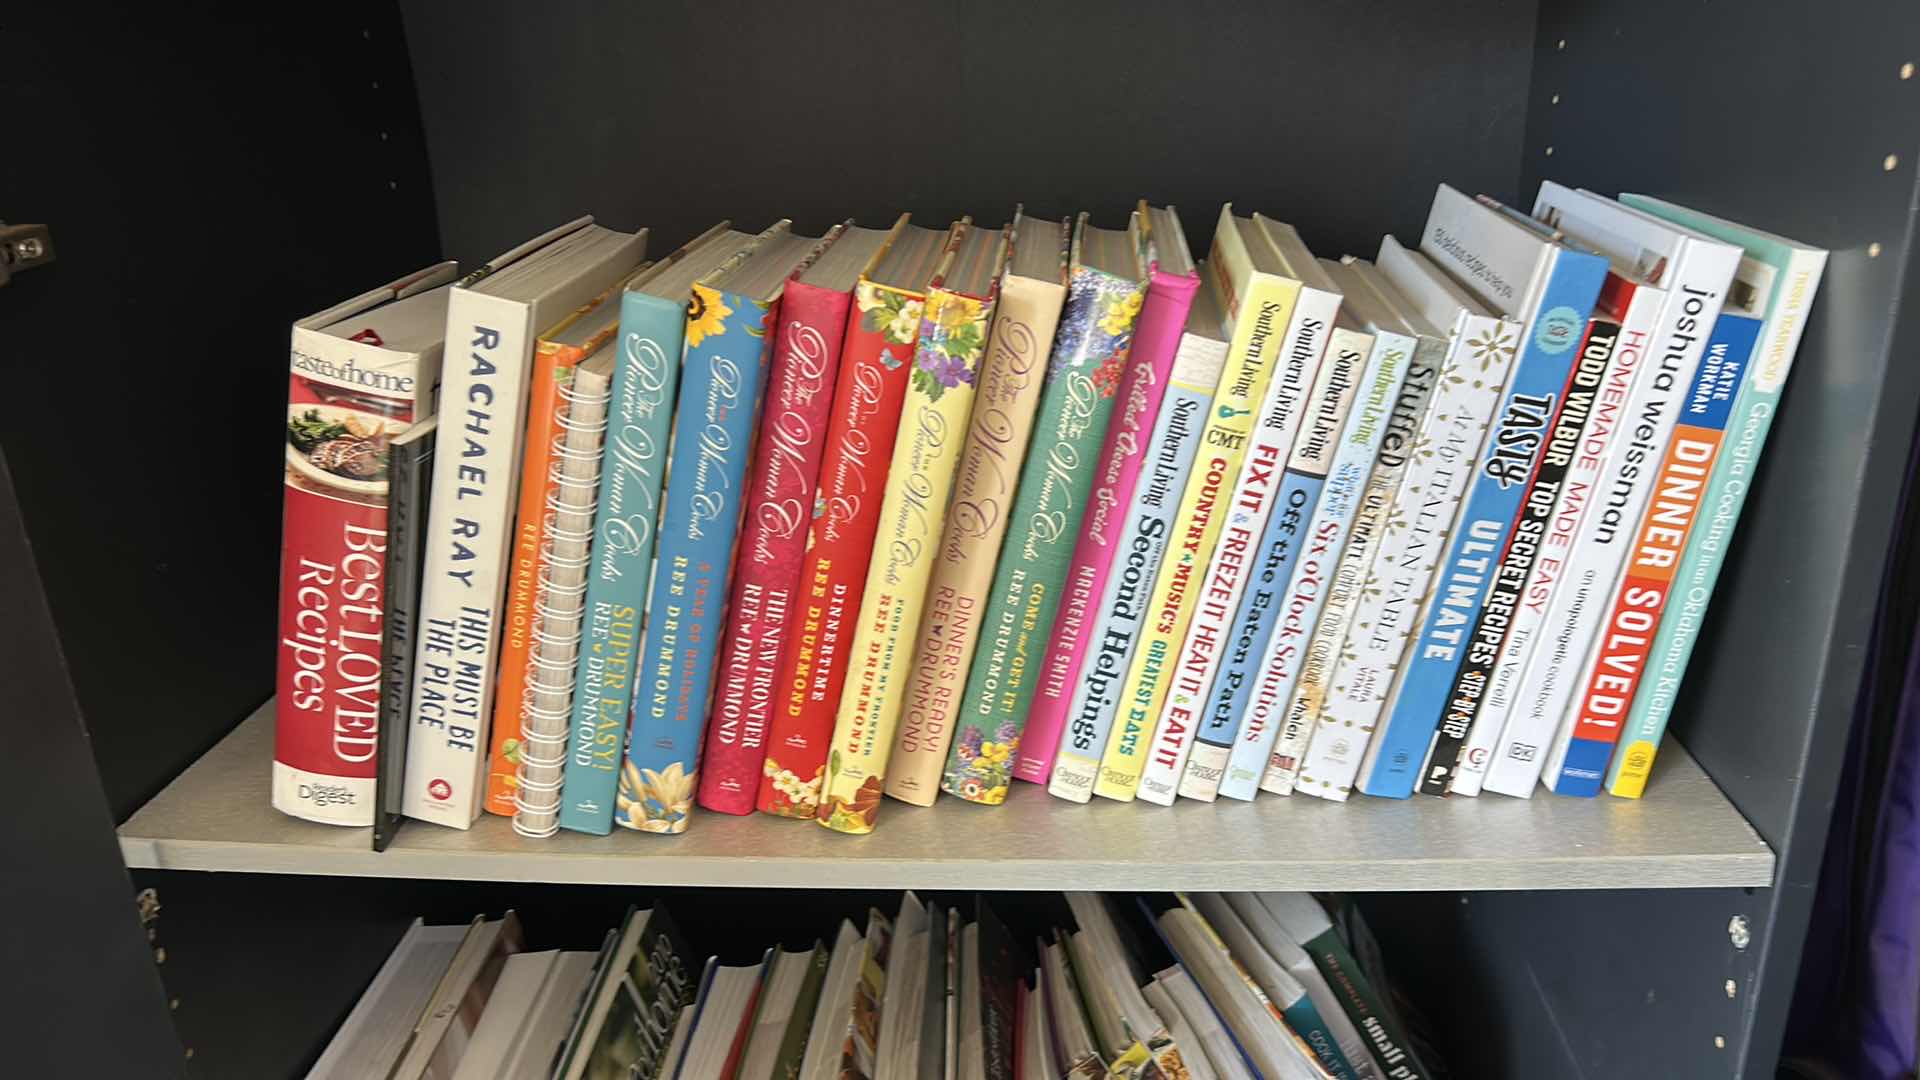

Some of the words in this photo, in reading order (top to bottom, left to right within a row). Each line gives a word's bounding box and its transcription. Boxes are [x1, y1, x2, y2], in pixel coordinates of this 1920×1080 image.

[780, 321, 828, 410] Pioneer
[1574, 328, 1618, 393] TODD
[1653, 285, 1715, 392] joshua
[621, 333, 668, 423] Pioneer
[1124, 362, 1156, 431] Grilled
[1578, 331, 1646, 473] HOMEMADE
[1690, 344, 1729, 413] WORKMAN
[1713, 362, 1740, 401] KATIE
[458, 326, 500, 500] RACHAEL
[1206, 428, 1245, 451] CMT
[1544, 387, 1596, 473] WILBUR
[1729, 402, 1772, 475] Georgia
[609, 425, 655, 517] Woman
[765, 411, 811, 505] Woman
[961, 405, 1011, 502] Woman
[1038, 442, 1079, 517] Woman
[1107, 432, 1139, 483] Cheese
[1248, 445, 1279, 487] FIX
[1594, 402, 1666, 544] weissman
[1090, 488, 1118, 546] Social
[1186, 458, 1227, 553] COUNTRY
[1234, 512, 1250, 525] &
[1241, 490, 1264, 513] IT
[1280, 489, 1307, 535] Off
[1349, 495, 1384, 558] ULTIMATE
[1400, 471, 1453, 570] ITALIAN
[1528, 482, 1561, 523] TOP
[1549, 482, 1589, 547] MADE
[1638, 440, 1714, 567] DINNER
[1703, 480, 1745, 552] Cooking
[450, 518, 480, 588] RAY
[524, 524, 538, 551] REE
[1111, 515, 1165, 621] Second
[1211, 527, 1251, 601] FREEZE
[1263, 540, 1288, 584] the
[1312, 520, 1339, 553] Six
[1498, 517, 1547, 593] SECRET
[342, 524, 387, 622] Best
[512, 559, 533, 648] DRUMMOND
[671, 556, 688, 596] REE
[741, 584, 763, 621] REE
[813, 558, 831, 597] REE
[933, 584, 955, 622] REE
[1007, 569, 1027, 606] REE
[1158, 564, 1193, 634] MUSIC'S
[1282, 561, 1323, 637] o'Clock
[1329, 564, 1360, 610] COMFORT
[1424, 520, 1503, 661] ULTIMATE
[1526, 558, 1561, 614] EASY
[285, 559, 336, 712] Recipes
[427, 619, 457, 656] THE
[459, 607, 490, 654] THIS
[592, 602, 612, 640] REE
[764, 590, 788, 624] THE
[874, 595, 892, 633] REE
[940, 596, 975, 680] DINNER'S
[1023, 583, 1045, 631] COME
[1206, 602, 1227, 621] IT
[1234, 589, 1273, 664] Eaten
[1320, 612, 1343, 637] FOOD
[1370, 578, 1413, 651] TABLE
[1469, 586, 1519, 670] RECIPES
[1552, 588, 1589, 664] unapologetic
[1664, 587, 1708, 674] Oklahoma
[606, 605, 635, 689] SUPER
[653, 606, 681, 718] DRUMMOND
[758, 626, 781, 665] NEW
[789, 606, 821, 716] DRUMMOND
[813, 584, 847, 701] DINNERTIME
[979, 613, 1015, 715] DRUMMOND
[1136, 640, 1168, 706] GREATEST
[1188, 625, 1219, 676] HEAT
[1303, 640, 1331, 688] COOKBOOK
[1509, 630, 1530, 657] Tina
[1584, 587, 1661, 727] SOLVED!
[334, 626, 382, 762] LOVED
[420, 663, 450, 729] PLACE
[453, 662, 483, 719] MUST
[720, 637, 753, 744] DRUMMOND
[743, 667, 774, 748] FRONTIER
[849, 642, 881, 754] DRUMMOND
[901, 637, 943, 753] DRUMMOND
[1001, 700, 1014, 713] IT!
[1005, 657, 1025, 696] GET
[1046, 655, 1071, 698] SMITH
[1074, 627, 1132, 750] Helpings
[1176, 693, 1192, 706] &
[1181, 677, 1201, 695] IT
[1212, 670, 1245, 728] Path
[1247, 643, 1295, 742] Solutions
[1349, 667, 1372, 703] VITALE
[1360, 670, 1380, 703] LAURA
[1531, 666, 1558, 719] cookbook
[1641, 676, 1678, 735] Kitchen
[449, 725, 475, 752] BE
[577, 657, 609, 767] DRUMMOND
[595, 698, 623, 770] EASY!
[924, 686, 952, 752] READY!
[1120, 708, 1146, 756] EATS
[1165, 707, 1192, 749] EAT
[1285, 698, 1312, 740] Whalen
[1157, 749, 1178, 770] IT
[1362, 1016, 1406, 1065] small
